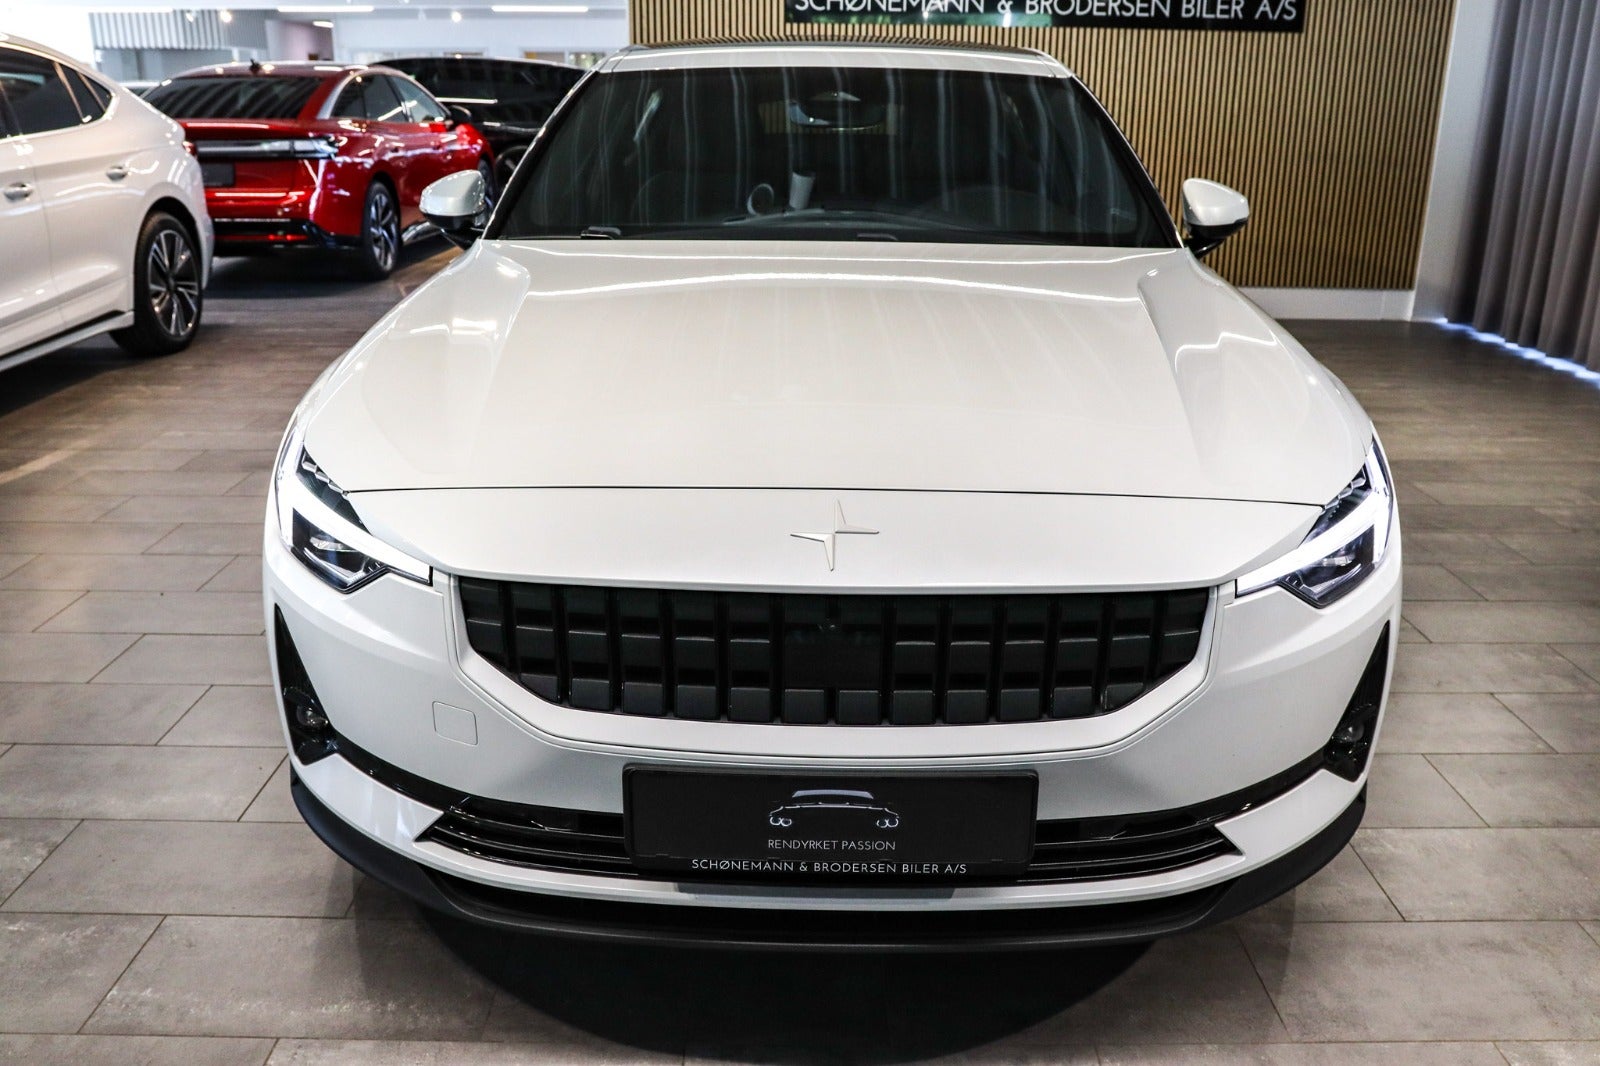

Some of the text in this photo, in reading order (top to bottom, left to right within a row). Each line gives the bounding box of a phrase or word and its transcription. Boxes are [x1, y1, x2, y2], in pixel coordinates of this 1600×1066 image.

[997, 0, 1012, 14] &
[1025, 0, 1170, 18] BRODERSEN
[1181, 0, 1243, 19] BILER
[1254, 0, 1297, 21] A/S
[768, 839, 896, 851] RENDYRKET PASSION
[691, 859, 967, 874] SCHØNEMANN & BRODERSEN BILER A/S
